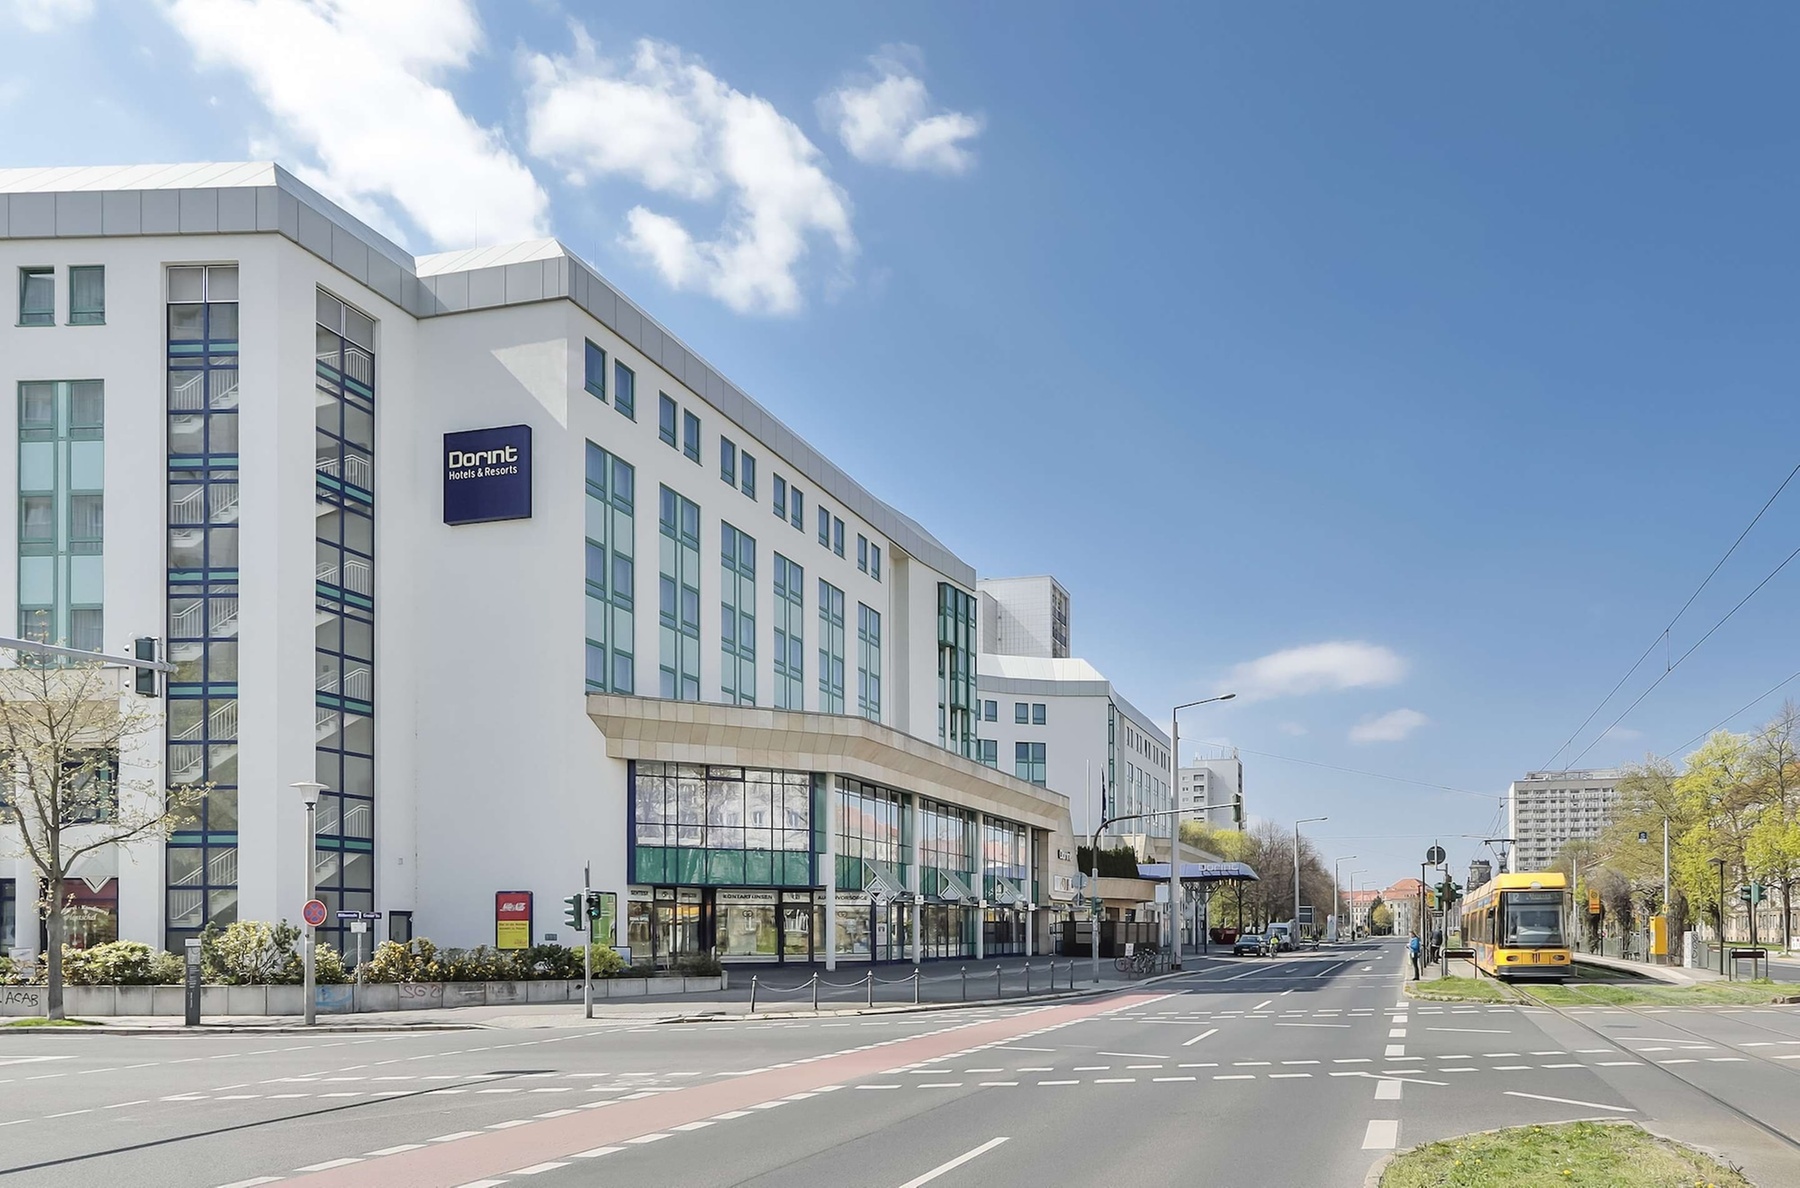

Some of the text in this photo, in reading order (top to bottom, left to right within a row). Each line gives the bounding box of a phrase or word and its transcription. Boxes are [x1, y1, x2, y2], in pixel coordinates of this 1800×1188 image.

[449, 446, 517, 468] Dorint
[449, 465, 517, 480] Hotels & Resorts
[1198, 863, 1239, 871] Dorint
[5, 991, 39, 1007] ACAB
